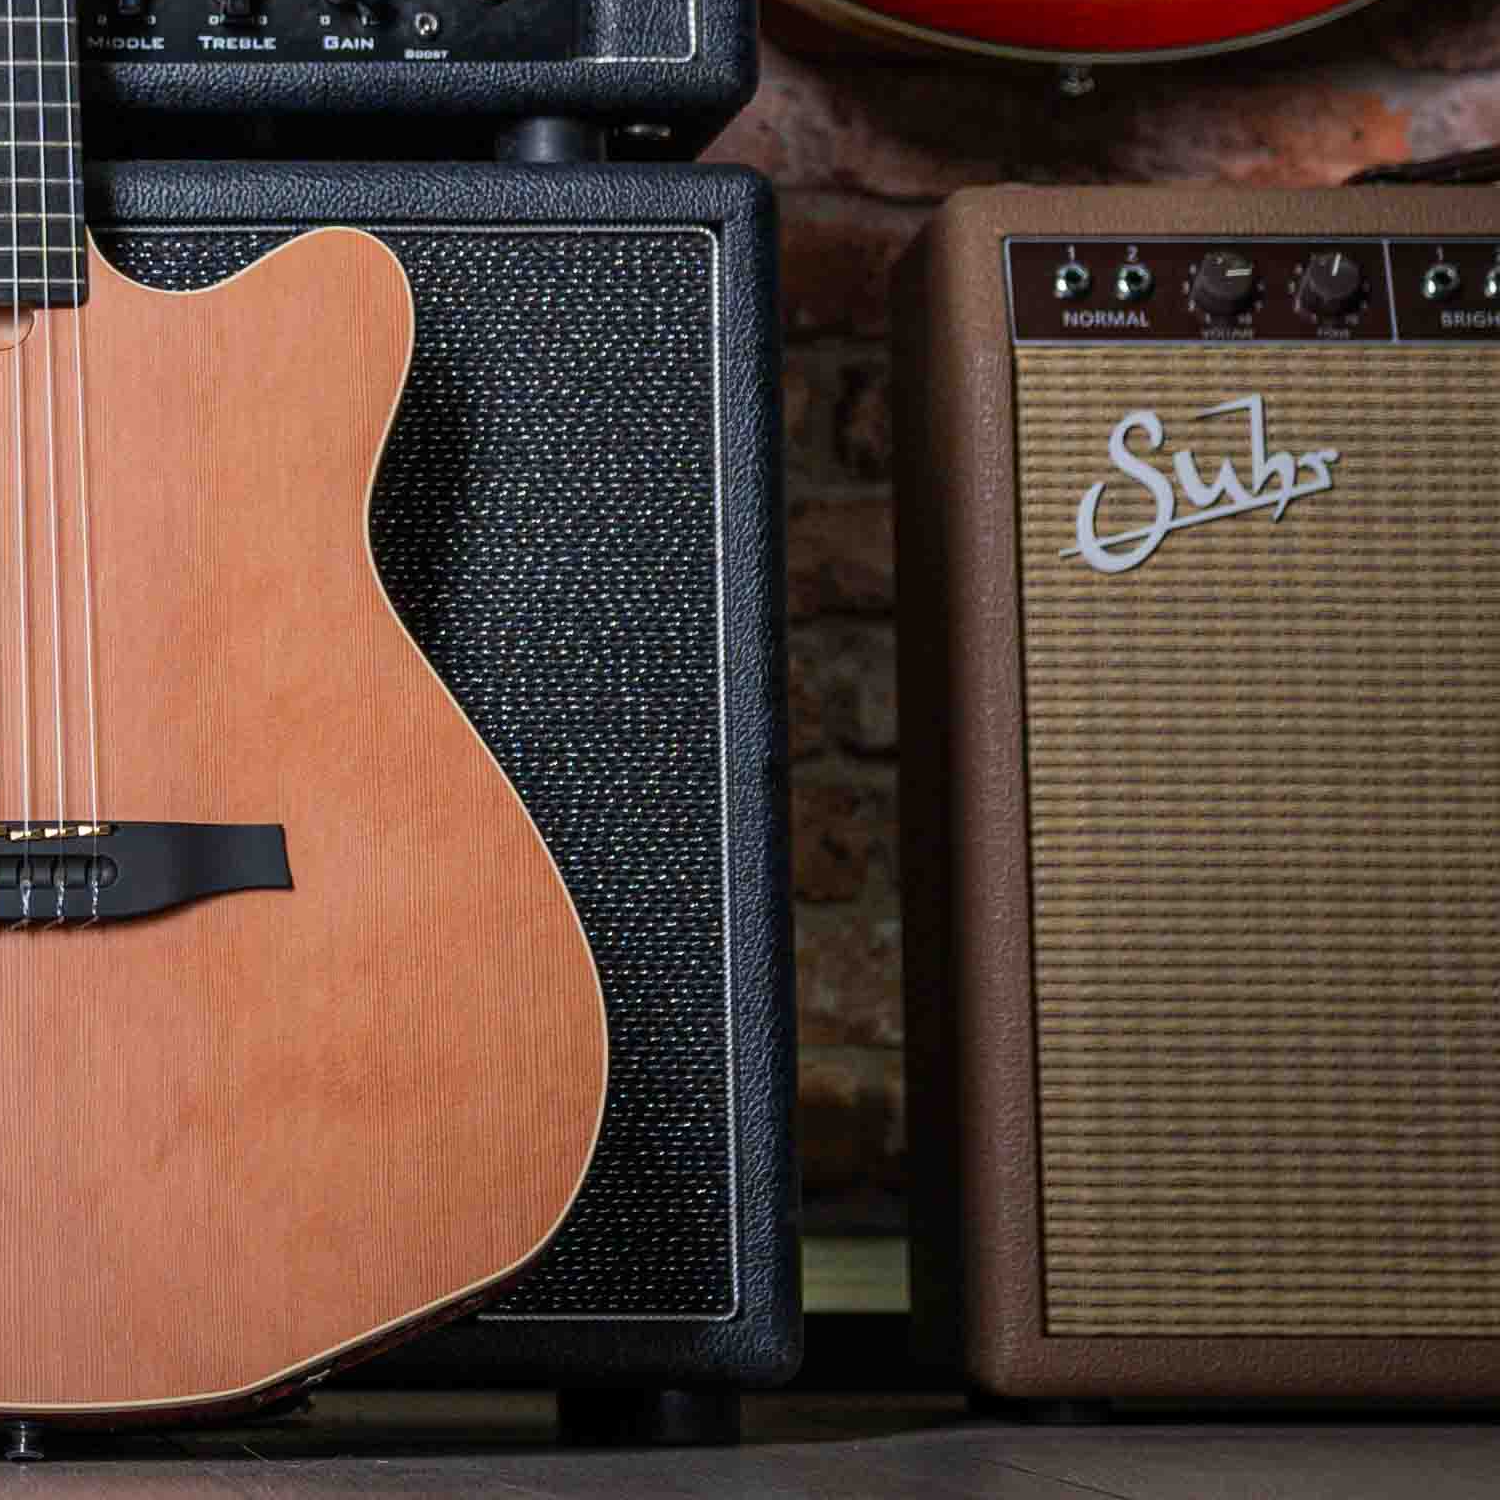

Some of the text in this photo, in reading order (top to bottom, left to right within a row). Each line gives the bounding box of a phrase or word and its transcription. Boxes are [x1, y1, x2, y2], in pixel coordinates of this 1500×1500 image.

[198, 36, 277, 50] TREBLE
[324, 36, 375, 50] GAIN
[404, 49, 449, 60] BOOST
[1062, 310, 1150, 328] NORMAL
[1440, 310, 1500, 329] BRIGH
[1058, 393, 1340, 573] Suhr
